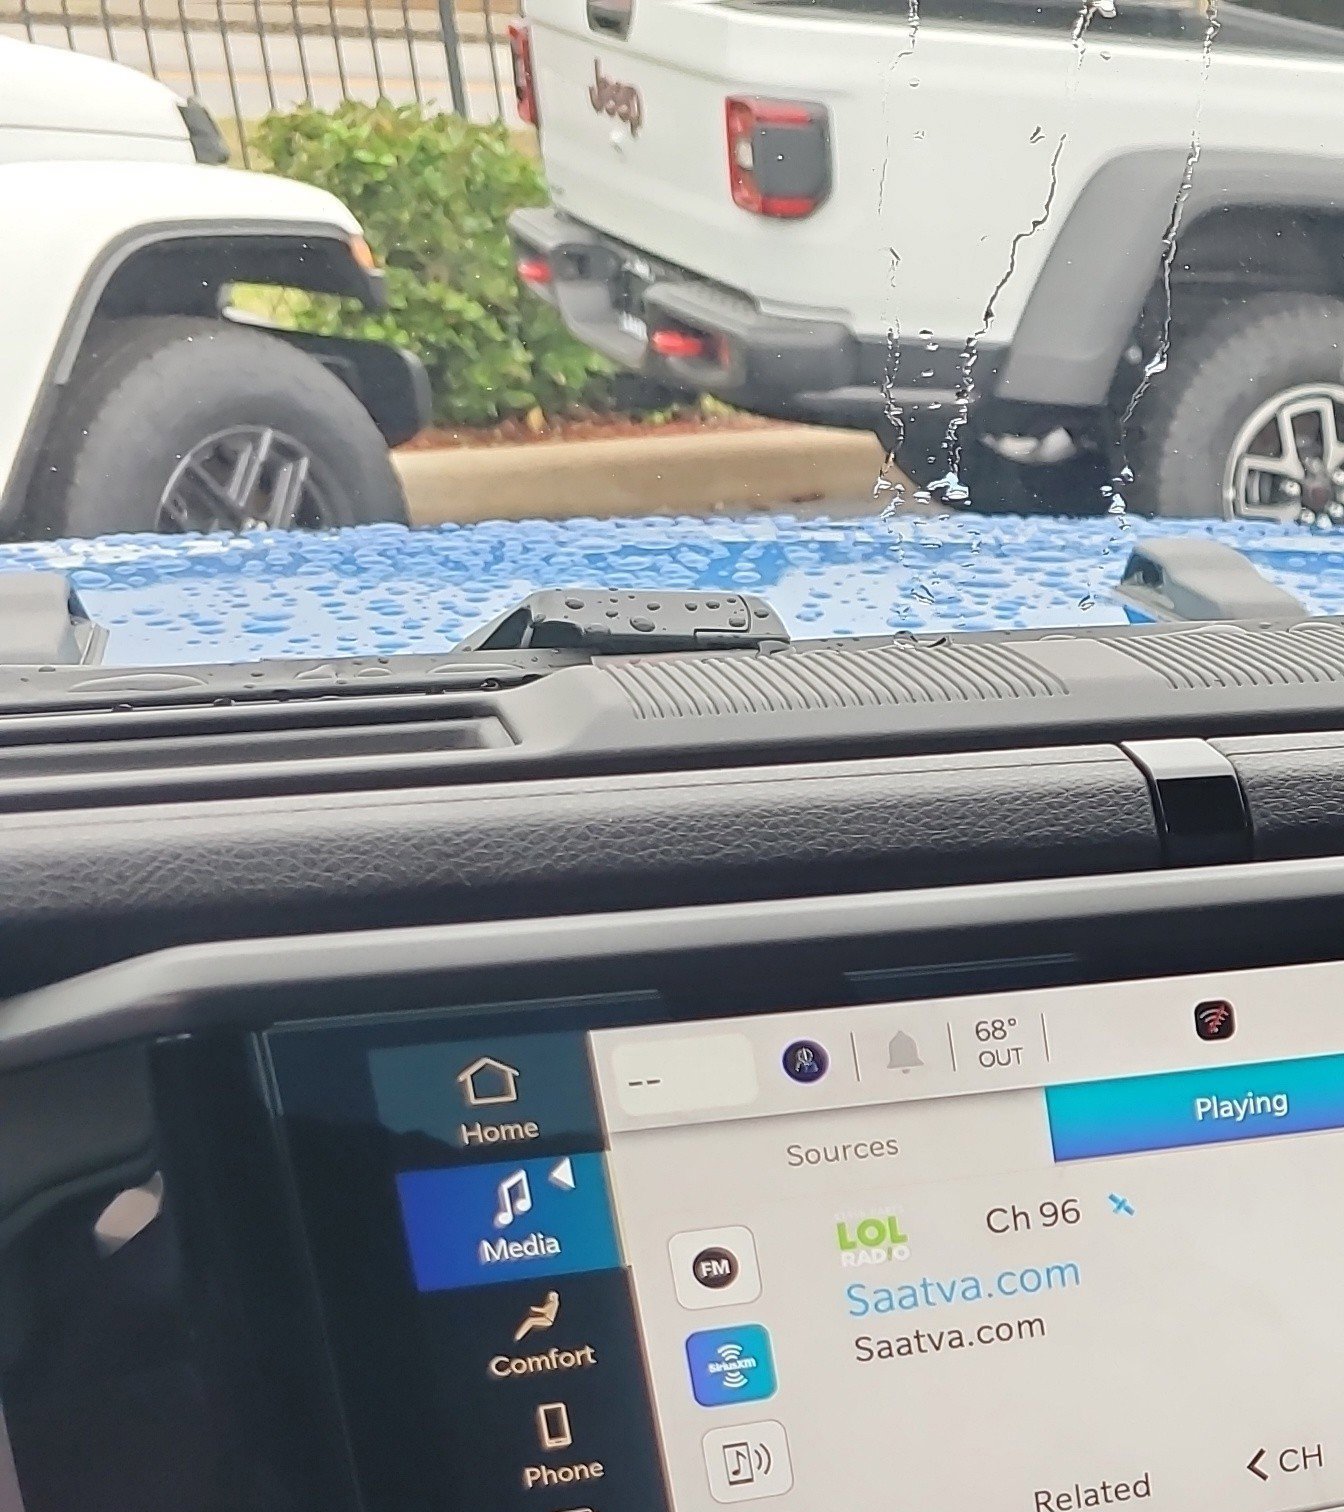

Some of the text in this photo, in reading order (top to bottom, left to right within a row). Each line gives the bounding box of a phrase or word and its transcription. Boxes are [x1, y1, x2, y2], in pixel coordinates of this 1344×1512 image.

[589, 57, 643, 138] Jeep
[975, 1017, 1017, 1042] 68°
[979, 1047, 1023, 1069] OUT
[1194, 1091, 1288, 1122] Playing
[460, 1120, 540, 1146] Home
[786, 1137, 899, 1167] Sources
[986, 1198, 1080, 1234] Ch 96
[480, 1233, 561, 1263] Media
[836, 1215, 909, 1251] LOL
[700, 1258, 731, 1277] FM
[846, 1262, 1081, 1318] Saatva.com
[854, 1316, 1046, 1363] Saatva.com
[489, 1345, 597, 1378] Comfort
[1279, 1444, 1324, 1473] CH
[523, 1462, 605, 1488] Phone
